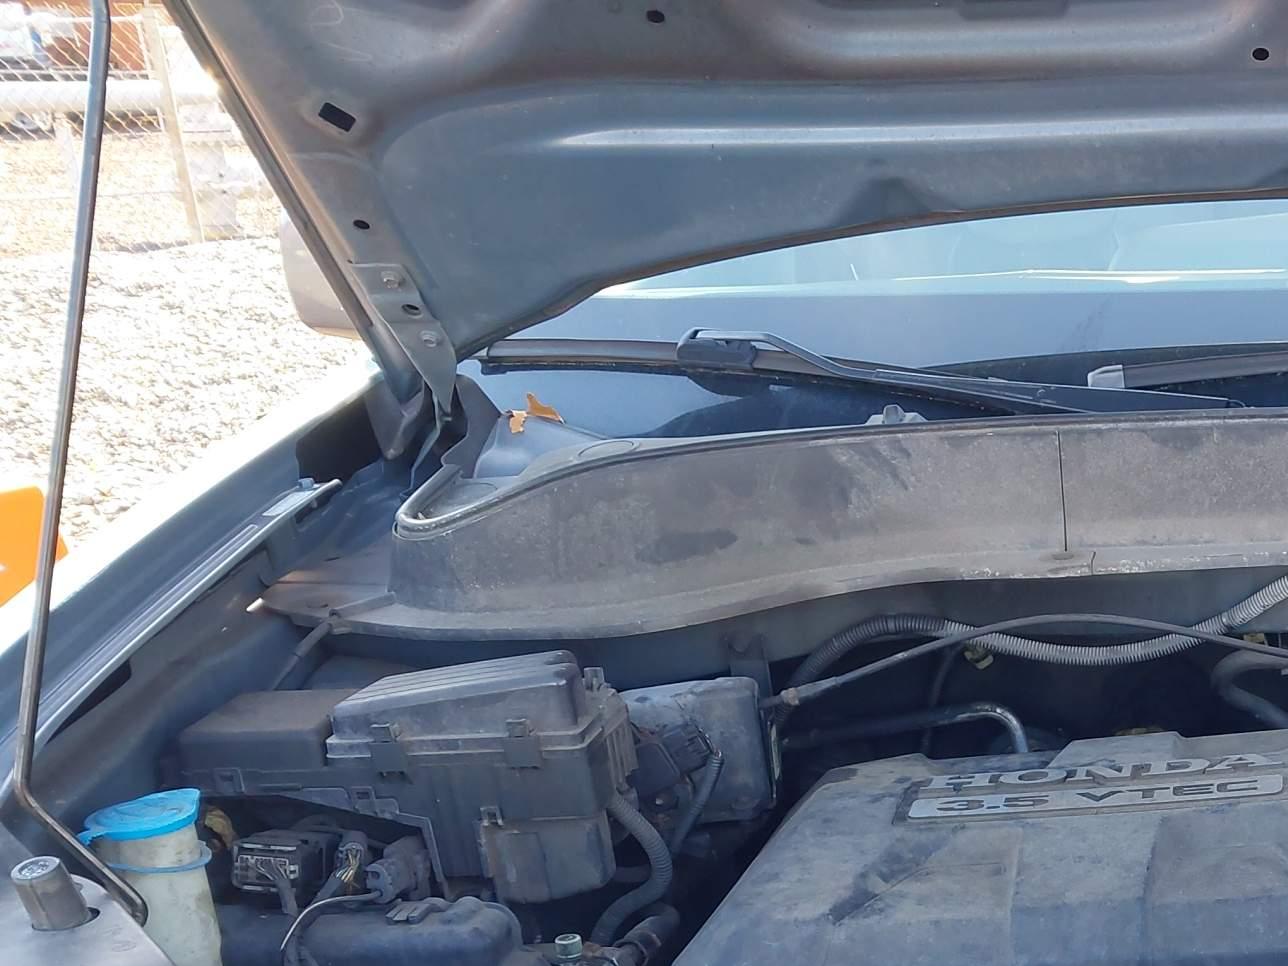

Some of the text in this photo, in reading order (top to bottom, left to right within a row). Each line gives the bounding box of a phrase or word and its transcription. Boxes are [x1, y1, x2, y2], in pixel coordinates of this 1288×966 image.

[919, 753, 1286, 792] HONDA
[936, 779, 1259, 812] 3.5 VTEC
